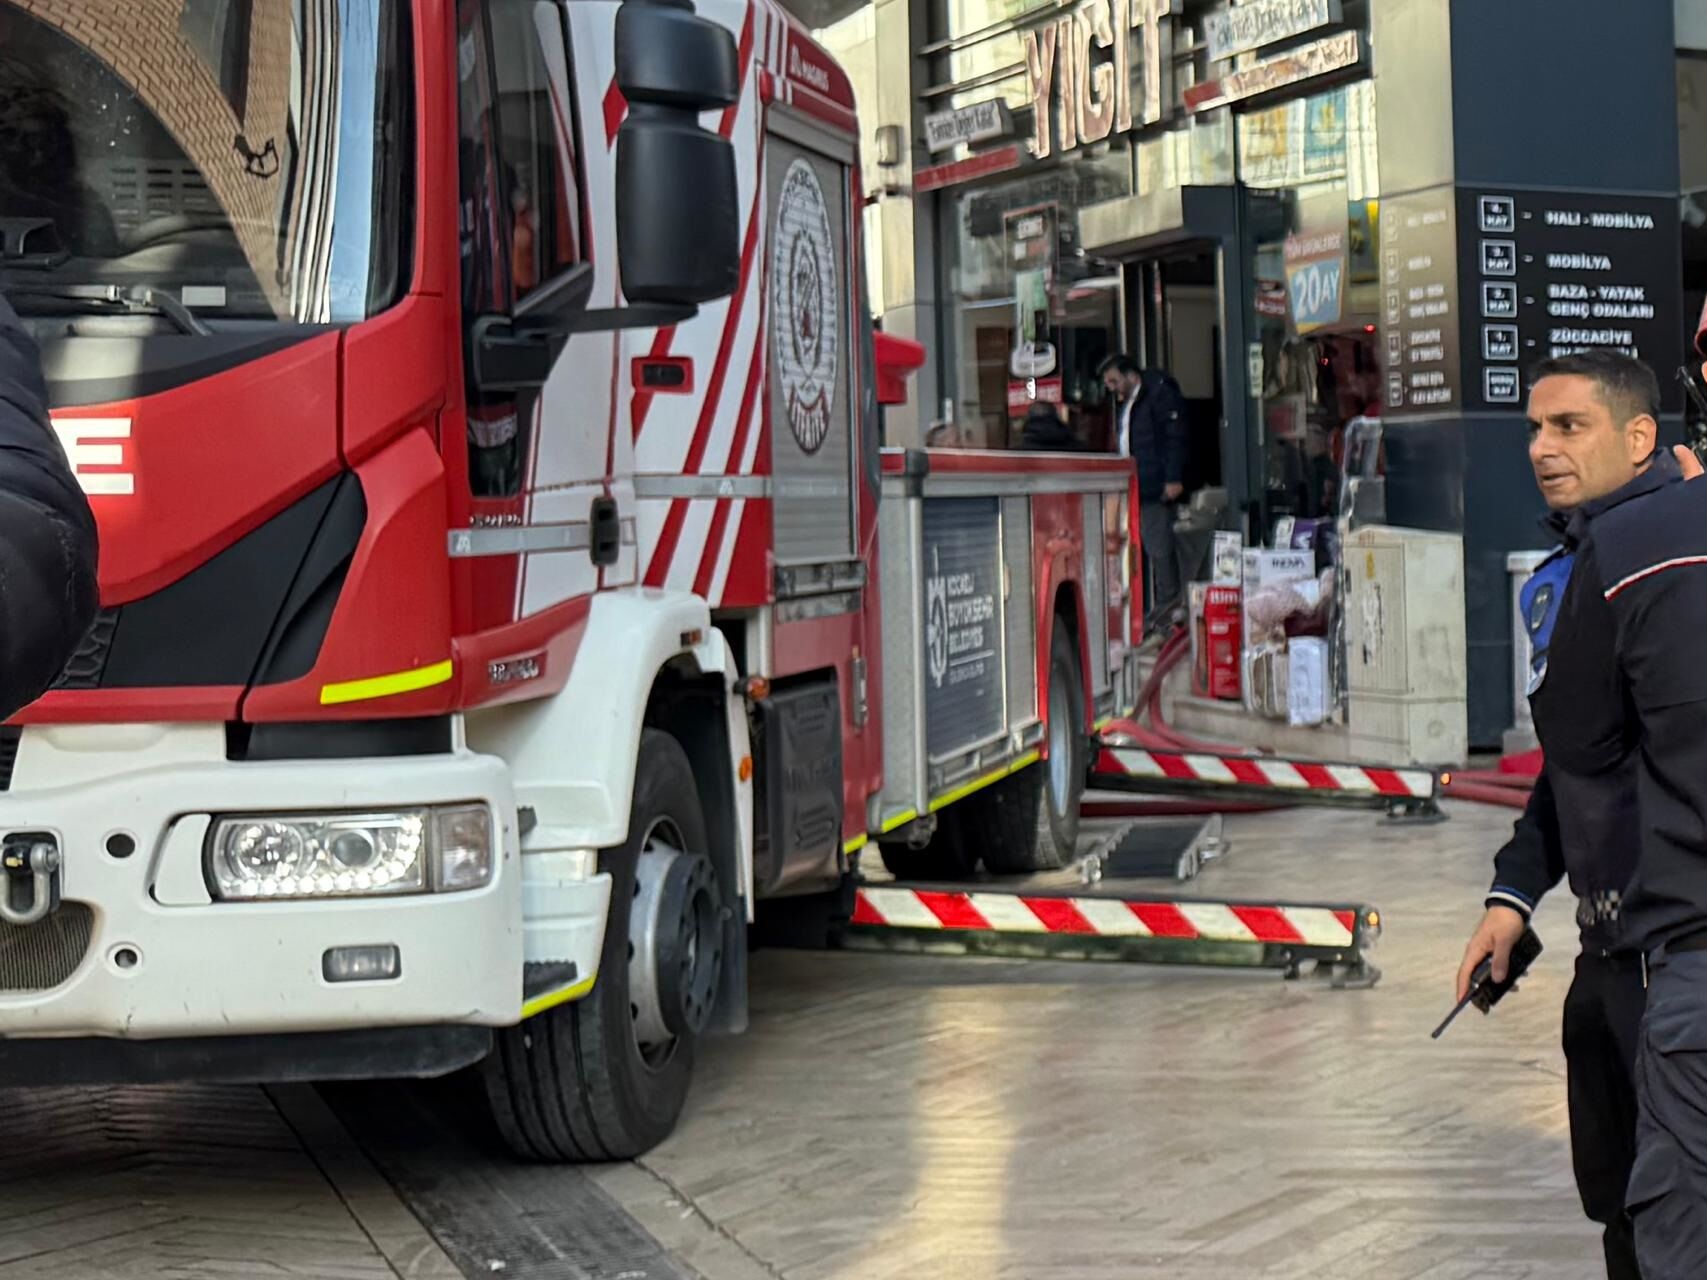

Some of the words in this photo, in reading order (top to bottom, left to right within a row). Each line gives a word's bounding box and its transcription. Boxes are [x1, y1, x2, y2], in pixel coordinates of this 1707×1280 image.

[1545, 210, 1581, 227] HALI
[1591, 212, 1654, 230] MOBİLYA
[1547, 252, 1612, 271] MOBİLYA
[1548, 284, 1589, 300] BAZA
[1599, 285, 1645, 302] YATAK
